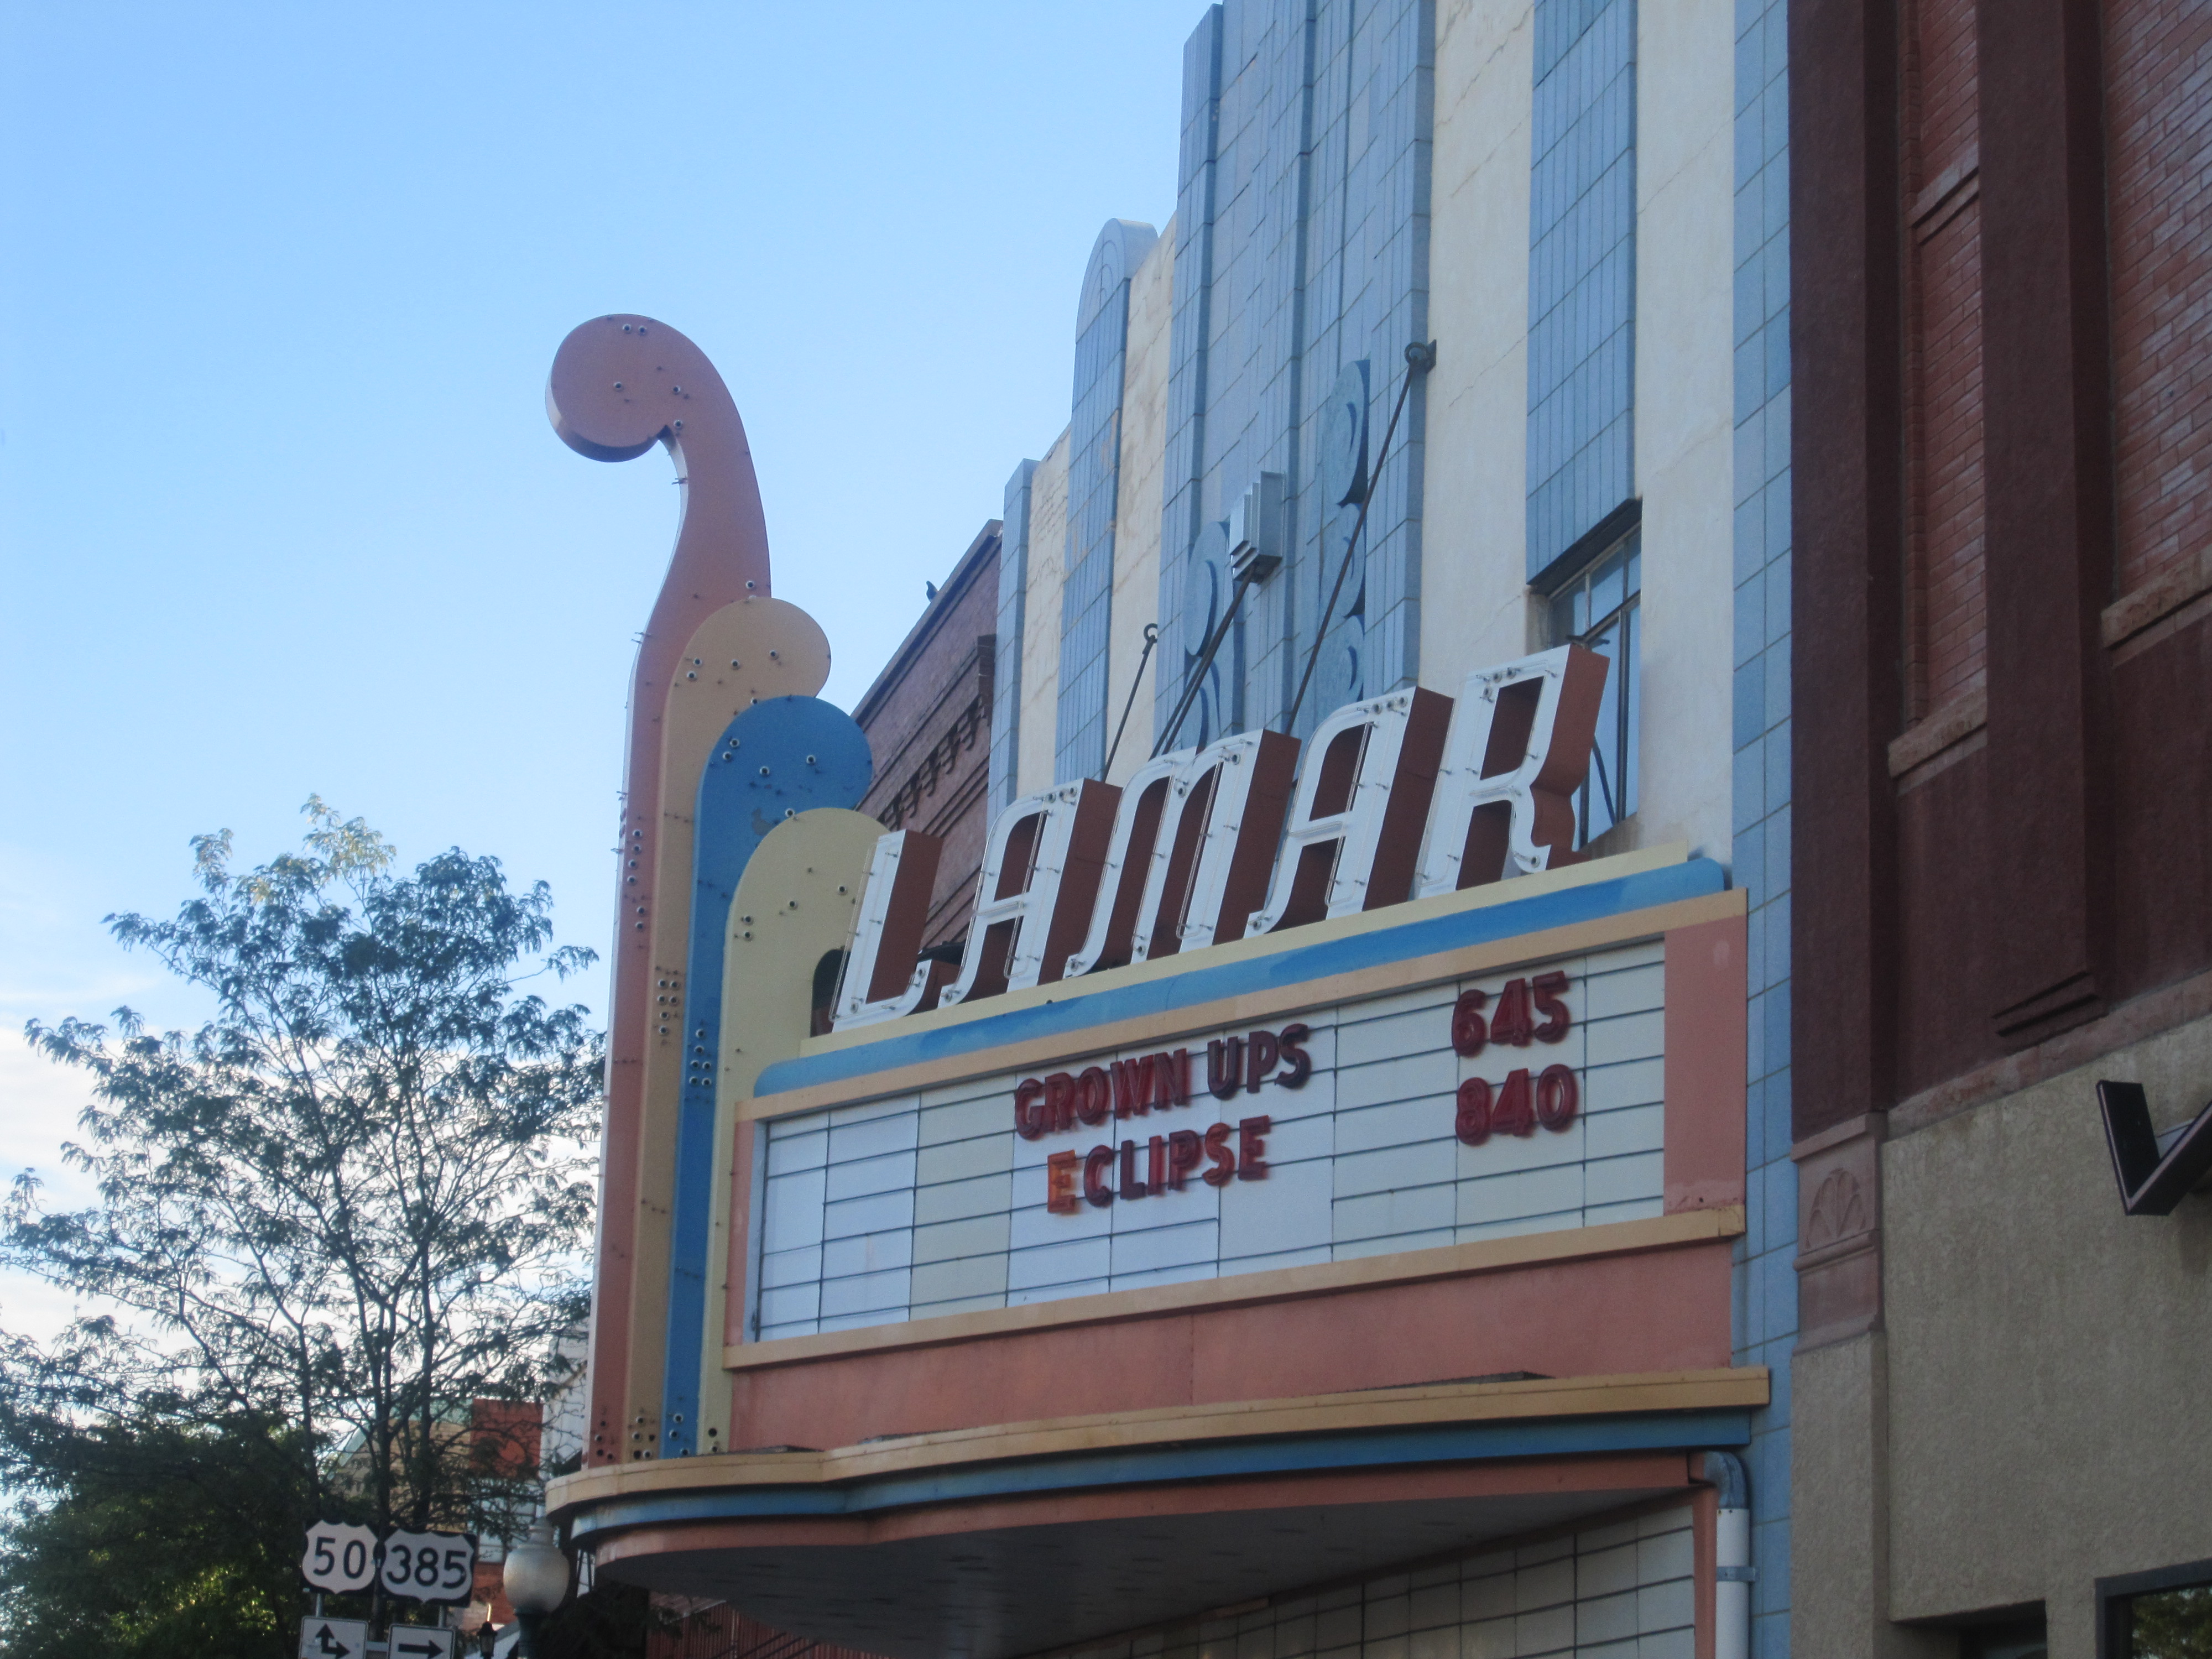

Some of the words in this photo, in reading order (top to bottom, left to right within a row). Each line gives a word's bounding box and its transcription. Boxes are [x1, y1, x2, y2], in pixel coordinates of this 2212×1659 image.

[830, 644, 1582, 1033] LAMAR
[1452, 971, 1570, 1057] 645
[1015, 1048, 1189, 1140] GROWN
[1207, 1023, 1311, 1099] UPS
[1455, 1063, 1579, 1146] 840
[1047, 1115, 1270, 1213] ECLIPSE
[313, 1536, 366, 1579] 50
[387, 1545, 467, 1589] 385
